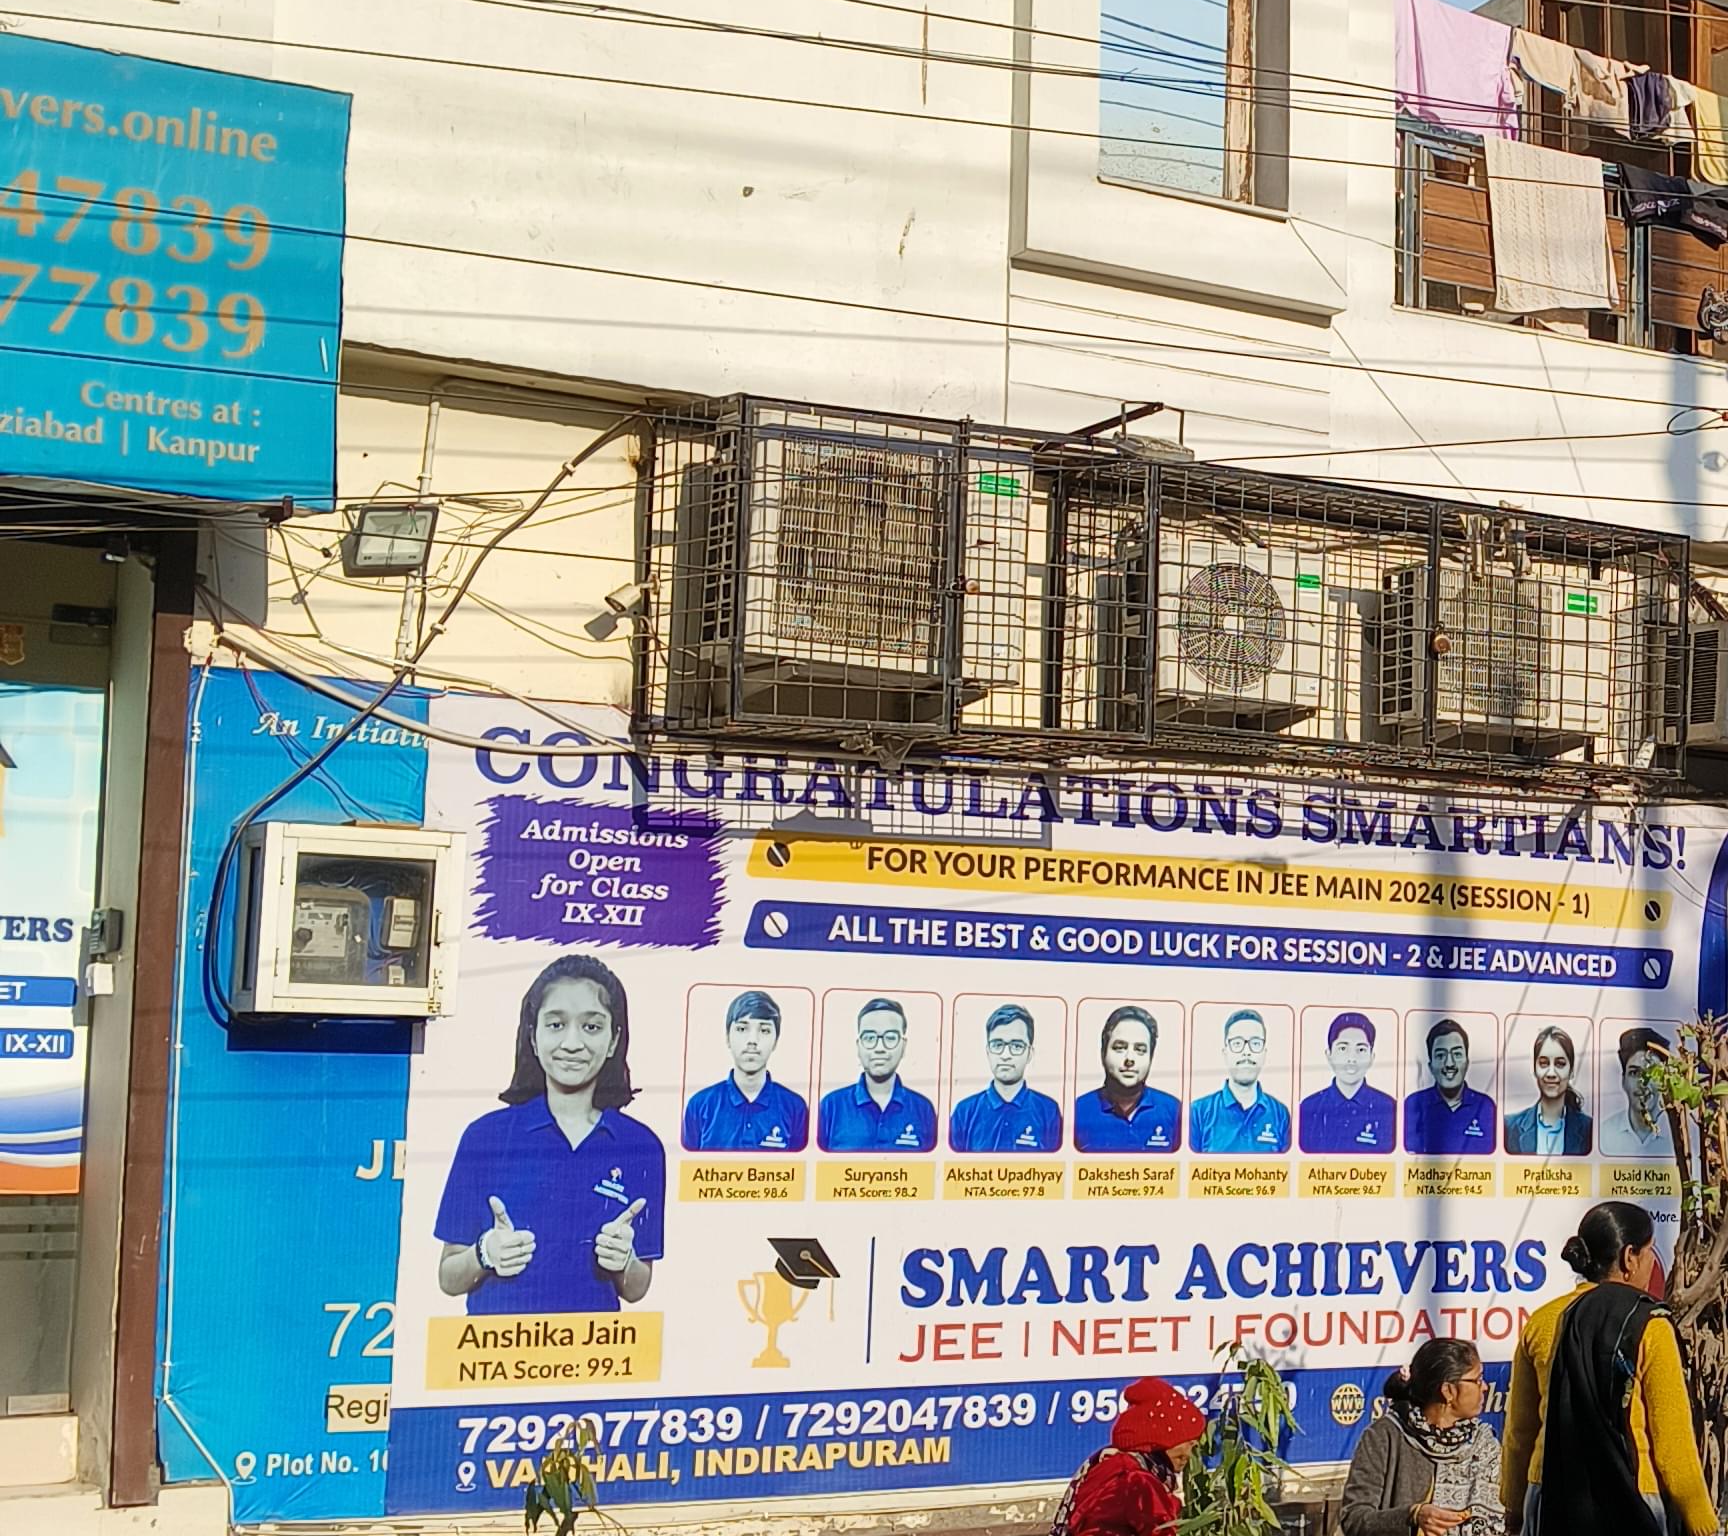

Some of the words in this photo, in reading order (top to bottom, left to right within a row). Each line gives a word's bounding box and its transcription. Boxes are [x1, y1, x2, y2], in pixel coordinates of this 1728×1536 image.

[0, 169, 272, 271] 47839
[0, 259, 266, 359] 77839
[80, 380, 202, 420] Centres
[212, 401, 241, 425] at
[147, 426, 260, 467] Kanpur
[252, 712, 300, 737] An
[520, 819, 689, 849] Admissions
[1301, 792, 1687, 871] SMARTIANS!
[568, 848, 642, 876] Open
[532, 873, 584, 899] for
[591, 876, 670, 901] Class
[867, 846, 928, 875] FOR
[935, 851, 1017, 880] YOUR
[1024, 856, 1230, 894] PERFORMANCE
[1236, 869, 1264, 895] IN
[1268, 871, 1309, 898] JEE
[1315, 875, 1383, 903] MAIN
[1389, 879, 1445, 907] 2024
[1450, 882, 1551, 914] (SESSION
[1571, 892, 1591, 919] 1)
[561, 902, 646, 926] IX-XII
[828, 914, 883, 944] ALL
[888, 917, 948, 946] THE
[954, 920, 1025, 950] BEST
[1028, 924, 1051, 951] &
[1056, 925, 1143, 956] GOOD
[1149, 929, 1219, 960] LUCK
[1225, 934, 1278, 963] FOR
[1283, 937, 1388, 967] SESSION
[1406, 943, 1422, 968] 2
[1426, 944, 1444, 969] &
[1447, 946, 1487, 972] JEE
[1489, 949, 1618, 979] ADVANCED
[5, 1034, 65, 1054] IX-XII
[692, 1167, 744, 1182] Atharv
[746, 1167, 795, 1182] Bansal
[843, 1168, 909, 1184] Suryansh
[946, 1167, 993, 1182] Akshat
[997, 1167, 1063, 1184] Upadhyay
[1078, 1167, 1140, 1181] Dakshesh
[1143, 1167, 1176, 1181] Saraf
[1191, 1167, 1231, 1182] Aditya
[1234, 1167, 1289, 1183] Mohanty
[1307, 1167, 1348, 1181] Atharv
[1350, 1168, 1388, 1183] Dubey
[1407, 1167, 1453, 1181] Madhav
[1455, 1167, 1492, 1181] Raman
[1523, 1168, 1573, 1182] Pratiksha
[1613, 1169, 1643, 1182] Usaid
[1644, 1169, 1671, 1182] Khan
[698, 1187, 723, 1199] NTA
[725, 1187, 762, 1199] Score:
[763, 1187, 789, 1199] 98.6
[832, 1187, 857, 1199] NTA
[894, 1187, 918, 1199] 98.2
[964, 1186, 987, 1197] NTA
[1087, 1185, 1110, 1197] NTA
[1143, 1185, 1165, 1197] 97.4
[1203, 1185, 1225, 1196] NTA
[1256, 1185, 1276, 1196] 96.9
[1312, 1185, 1333, 1196] NTA
[1416, 1184, 1436, 1195] NTA
[1515, 1184, 1535, 1195] NTA
[1611, 1185, 1630, 1196] NTA
[900, 1242, 1161, 1309] SMART
[1174, 1239, 1548, 1301] ACHIEVERS
[456, 1321, 575, 1351] Anshika
[580, 1318, 638, 1349] Jain
[898, 1321, 1003, 1364] JEE
[1051, 1314, 1191, 1356] NEET
[458, 1359, 508, 1382] NTA
[513, 1358, 581, 1380] Score:
[586, 1357, 634, 1378] 99.1
[457, 1406, 743, 1454] 7292077839
[782, 1390, 1037, 1439] 7292047839
[266, 1453, 315, 1477] Plot
[321, 1451, 359, 1475] No.
[693, 1435, 952, 1478] INDIRAPURAM
